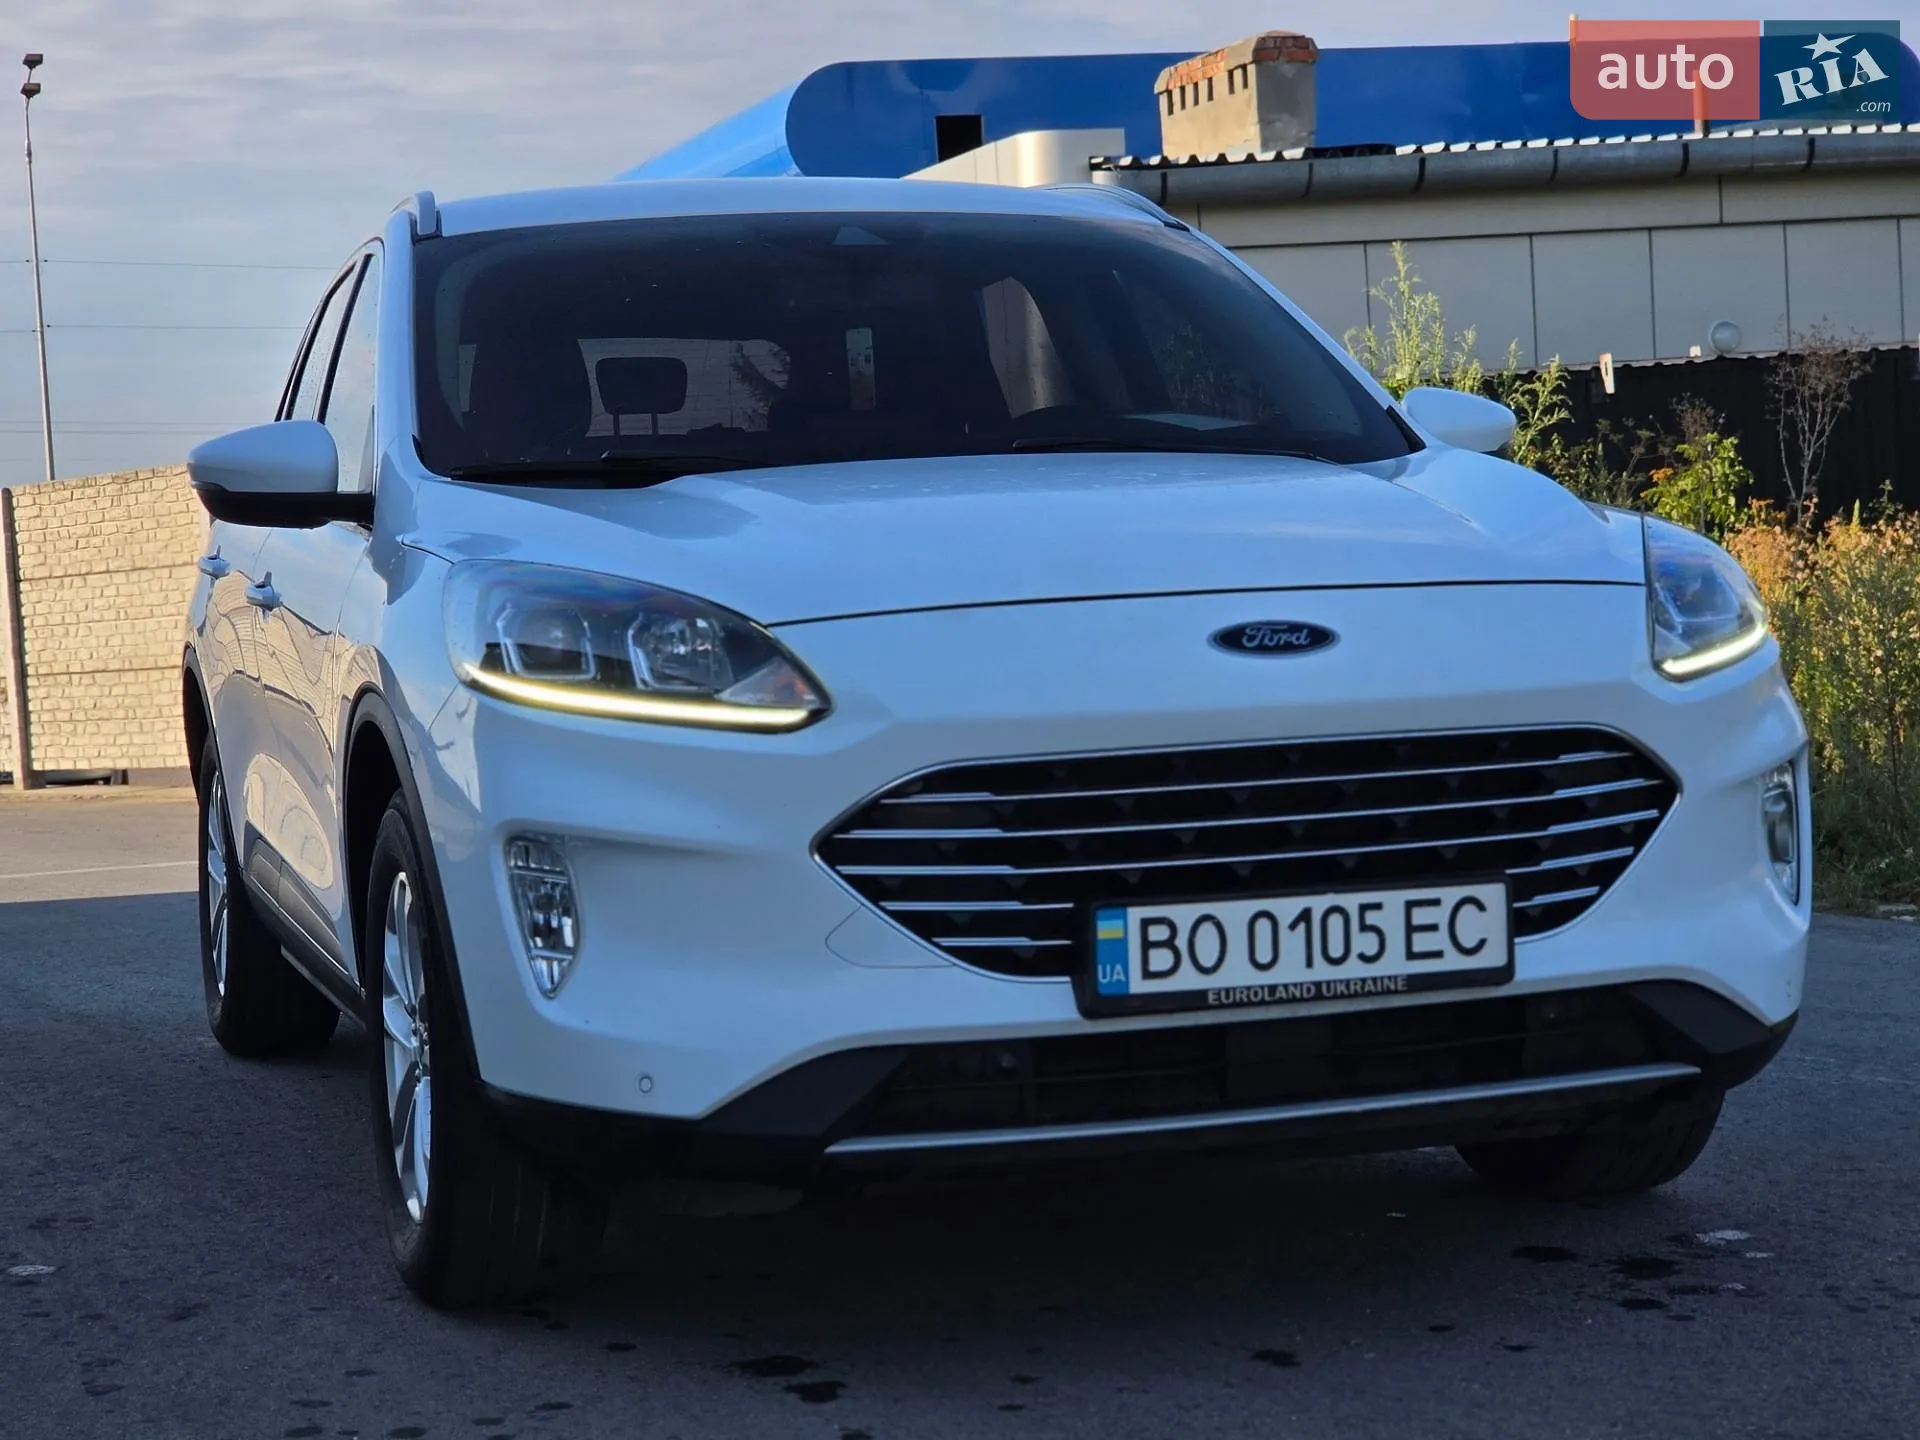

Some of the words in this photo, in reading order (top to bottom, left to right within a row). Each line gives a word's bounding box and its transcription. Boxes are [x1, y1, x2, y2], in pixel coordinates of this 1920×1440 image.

[1241, 624, 1311, 648] Ford
[1139, 913, 1228, 981] BO
[1247, 902, 1387, 973] 0105
[1404, 895, 1488, 962] EC
[1097, 964, 1127, 984] UA
[1207, 983, 1316, 1005] EUROLAND
[1321, 974, 1409, 998] UKRAINE
